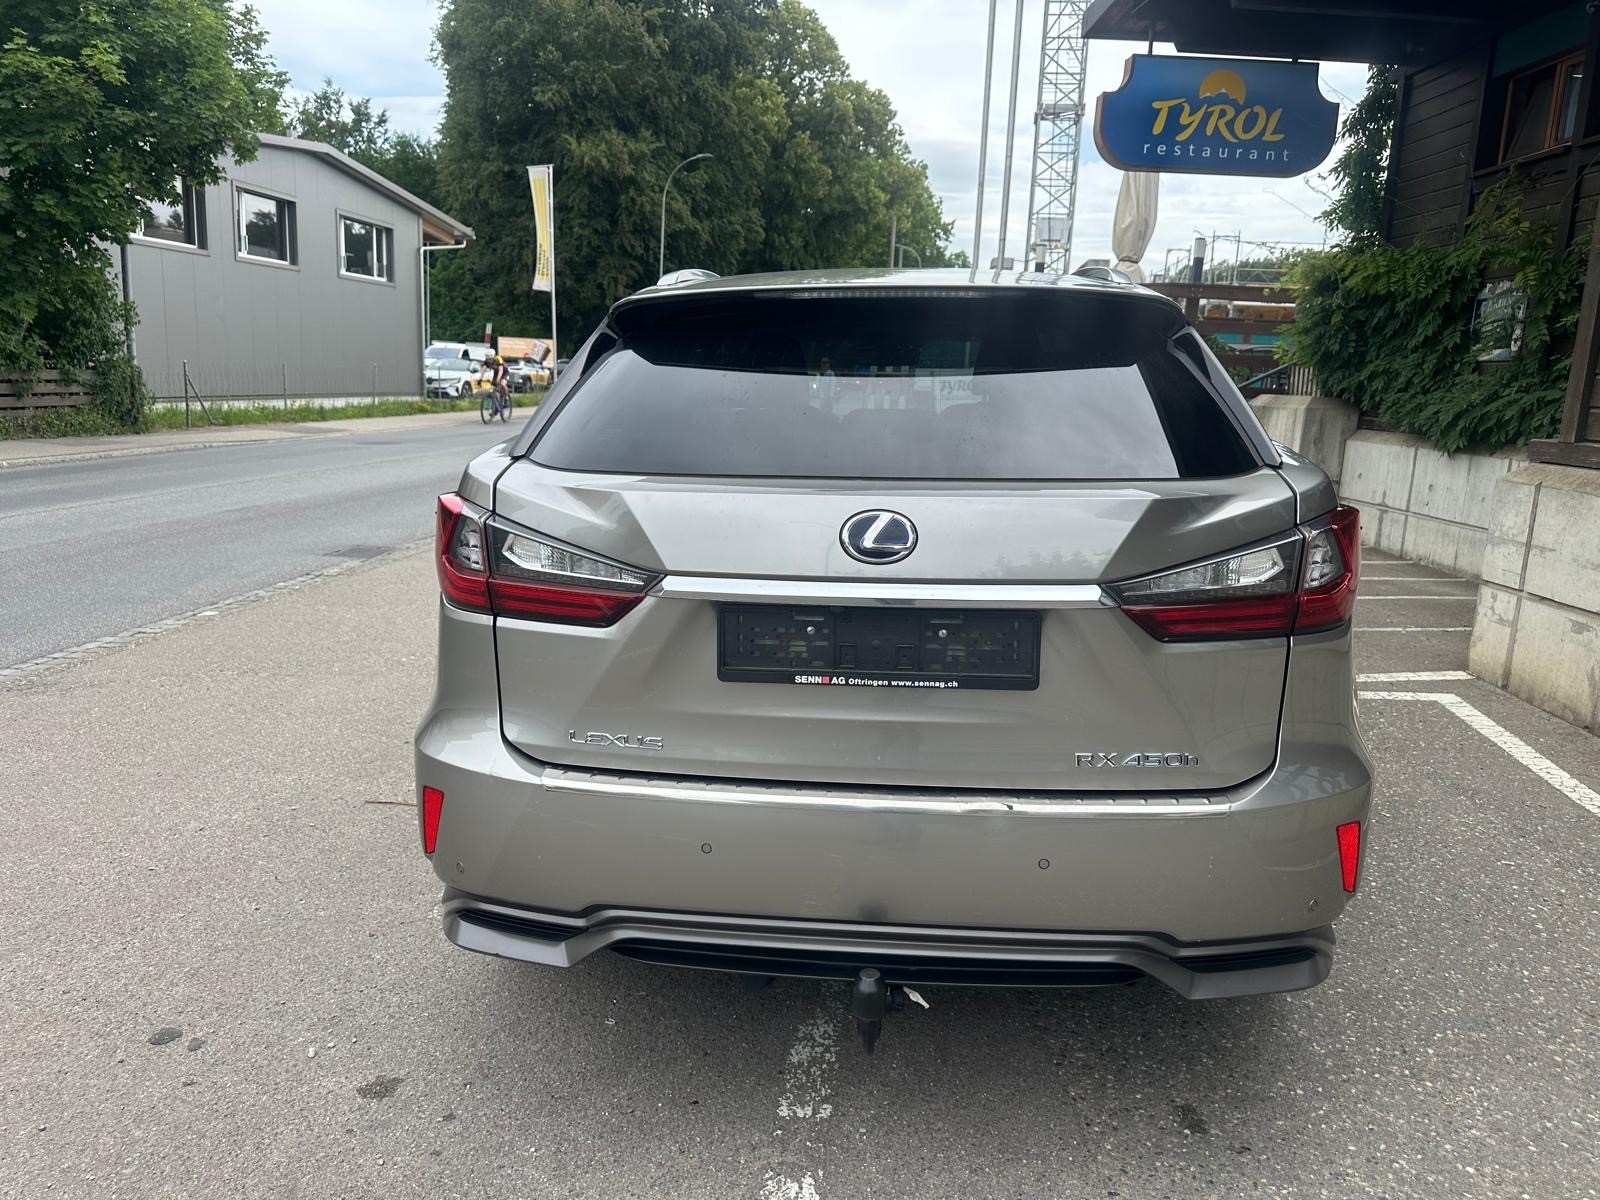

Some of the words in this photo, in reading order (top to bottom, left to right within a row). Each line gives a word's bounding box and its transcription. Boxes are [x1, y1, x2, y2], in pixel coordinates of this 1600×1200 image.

[1151, 98, 1286, 144] TYROL
[1143, 143, 1291, 162] restaurant
[831, 676, 846, 685] AG
[848, 678, 889, 687] Oftringen
[890, 680, 959, 689] www.sennag.ch
[569, 729, 664, 750] LEXUS
[1074, 752, 1119, 768] RX
[1121, 752, 1200, 768] 450h
